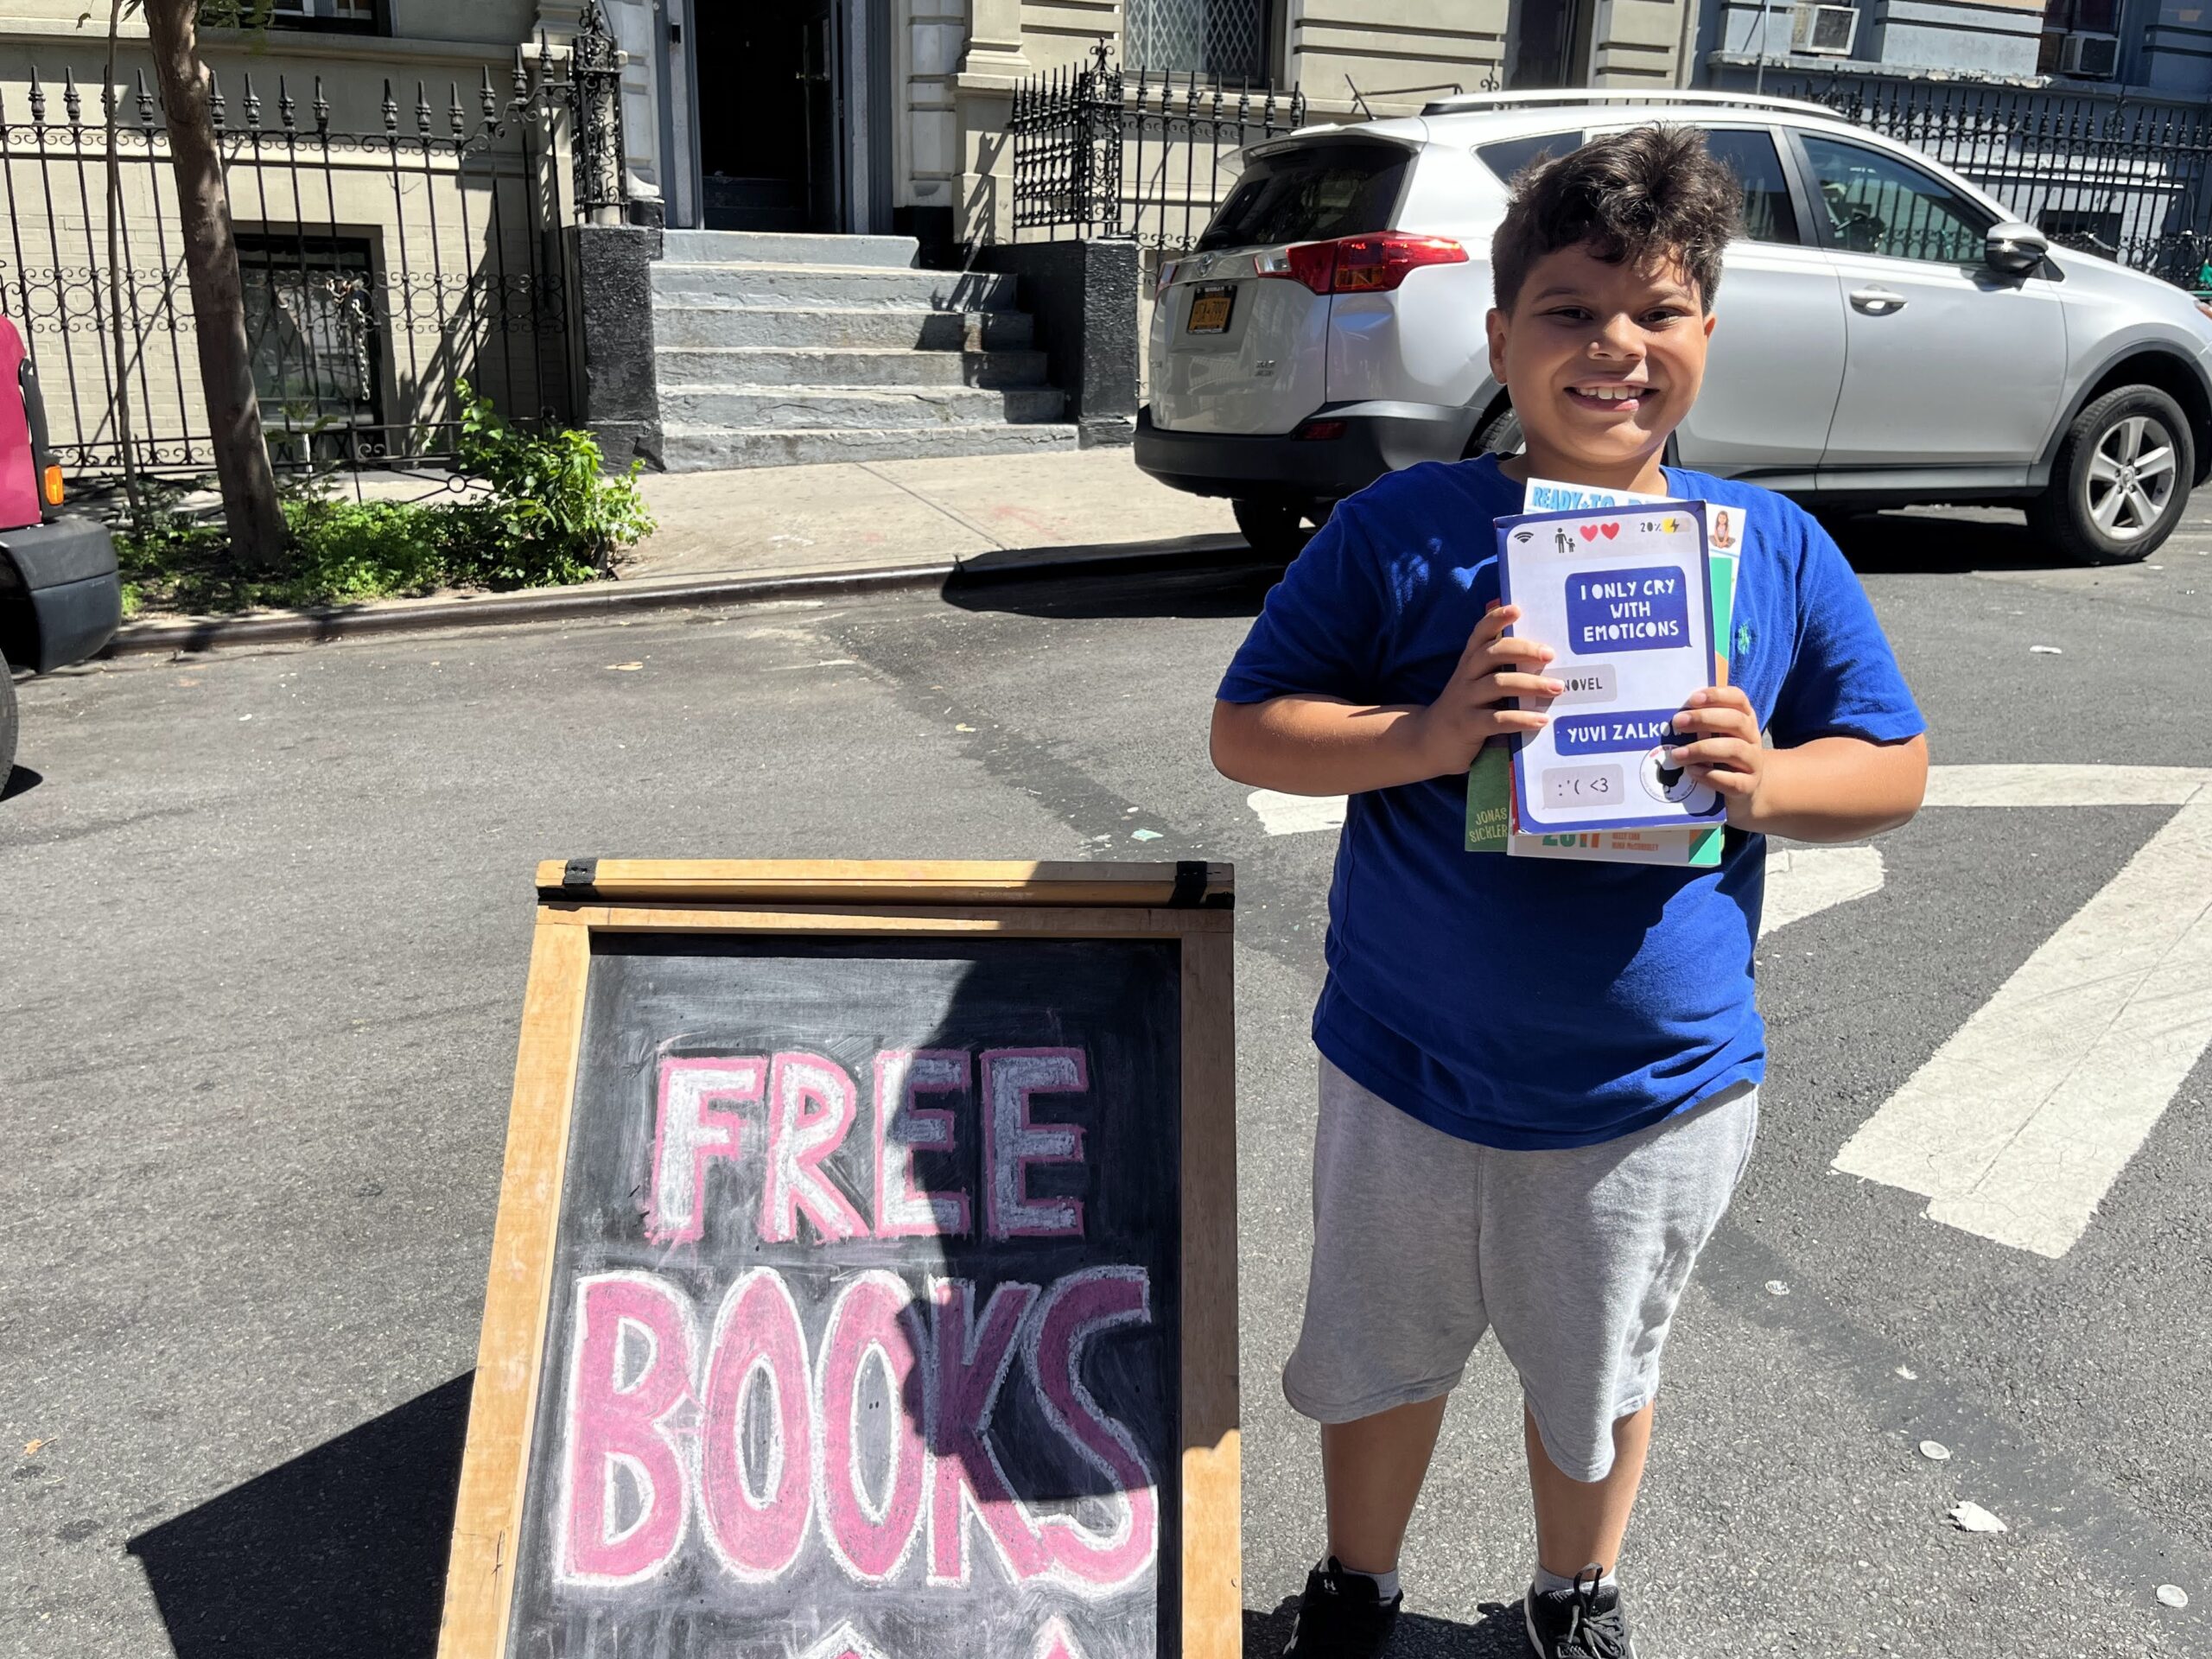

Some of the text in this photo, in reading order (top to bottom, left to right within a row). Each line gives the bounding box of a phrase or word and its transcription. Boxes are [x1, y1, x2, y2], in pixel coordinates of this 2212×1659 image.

[1640, 522, 1662, 532] 20%
[1580, 579, 1675, 601] I ONLY CRY
[1610, 601, 1651, 619] WITH
[1583, 620, 1680, 642] EMOTICONS
[1563, 677, 1603, 692] NOVEL
[1567, 725, 1606, 743] YUVI
[1475, 807, 1507, 826] JONAS
[1469, 823, 1508, 843] SICKLER
[645, 1048, 1089, 1245] FREE
[554, 1265, 1159, 1598] BOOKS
